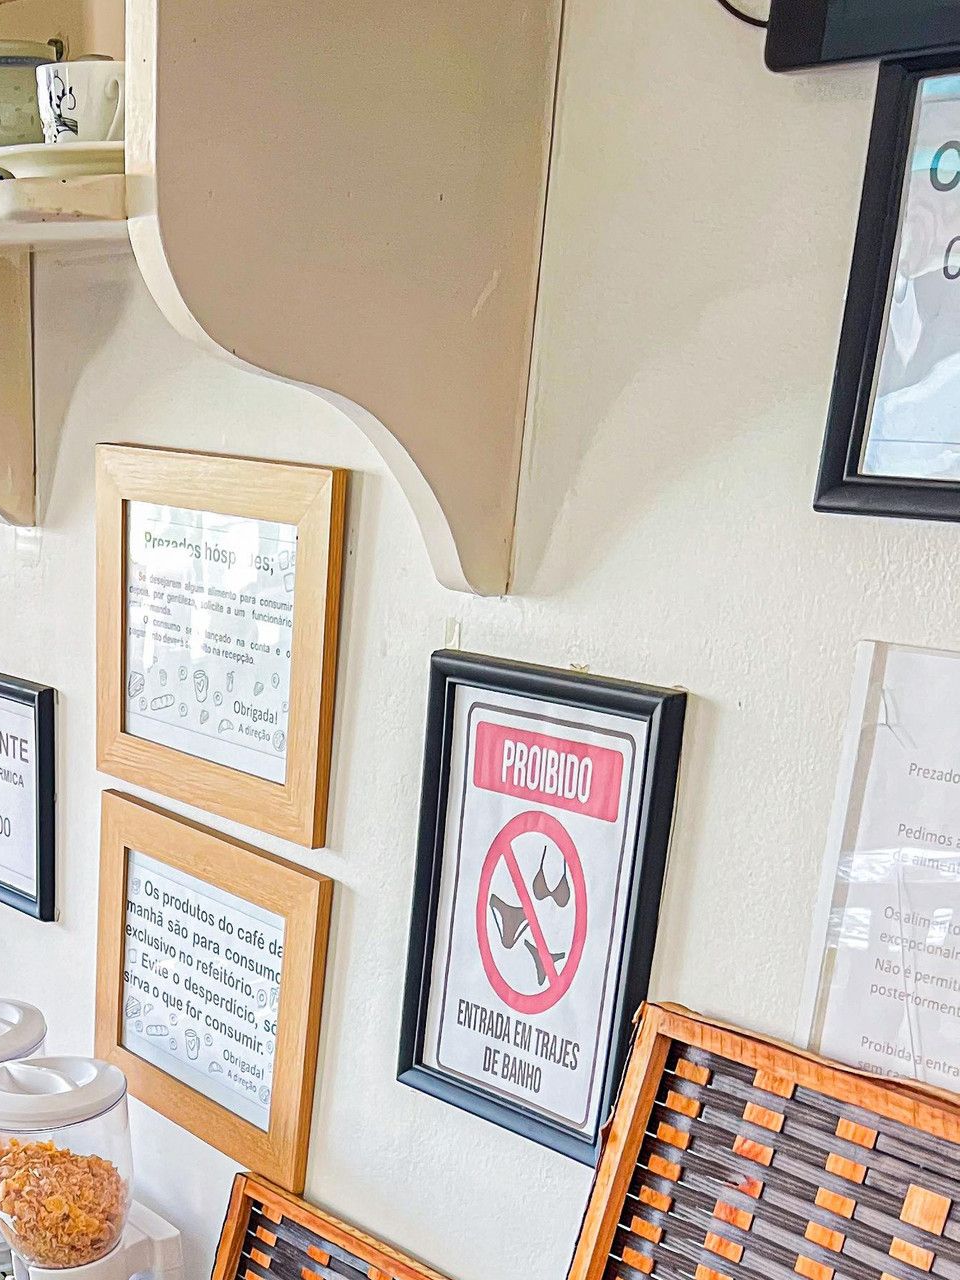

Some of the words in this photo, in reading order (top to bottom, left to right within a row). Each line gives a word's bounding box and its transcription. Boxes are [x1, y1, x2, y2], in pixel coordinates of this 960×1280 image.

[236, 638, 245, 648] na
[233, 700, 278, 725] Obrigada!
[500, 738, 595, 805] PROIBIDO
[897, 823, 953, 847] Pedimos
[126, 899, 163, 927] manhã
[167, 919, 188, 939] são
[192, 932, 220, 955] para
[144, 880, 159, 900] Os
[162, 891, 215, 926] produtos
[218, 916, 234, 934] do
[237, 927, 265, 950] café
[884, 906, 901, 921] Os
[125, 924, 176, 958] exclusivo
[179, 950, 193, 967] no
[196, 959, 255, 999] refeitório.
[874, 957, 901, 976] Não
[904, 964, 912, 979] é
[124, 970, 150, 993] sirva
[152, 986, 159, 998] o
[162, 991, 183, 1011] que
[186, 1000, 202, 1021] for
[205, 1014, 264, 1056] consumir.
[173, 972, 180, 985] o
[184, 976, 258, 1030] desperdício,
[456, 998, 513, 1045] ENTRADA
[513, 1023, 533, 1056] EM
[534, 1027, 581, 1071] TRAJES
[860, 1035, 912, 1062] Proibida
[222, 1049, 265, 1081] Obrigada!
[482, 1045, 499, 1075] DE
[501, 1055, 543, 1094] BANHO
